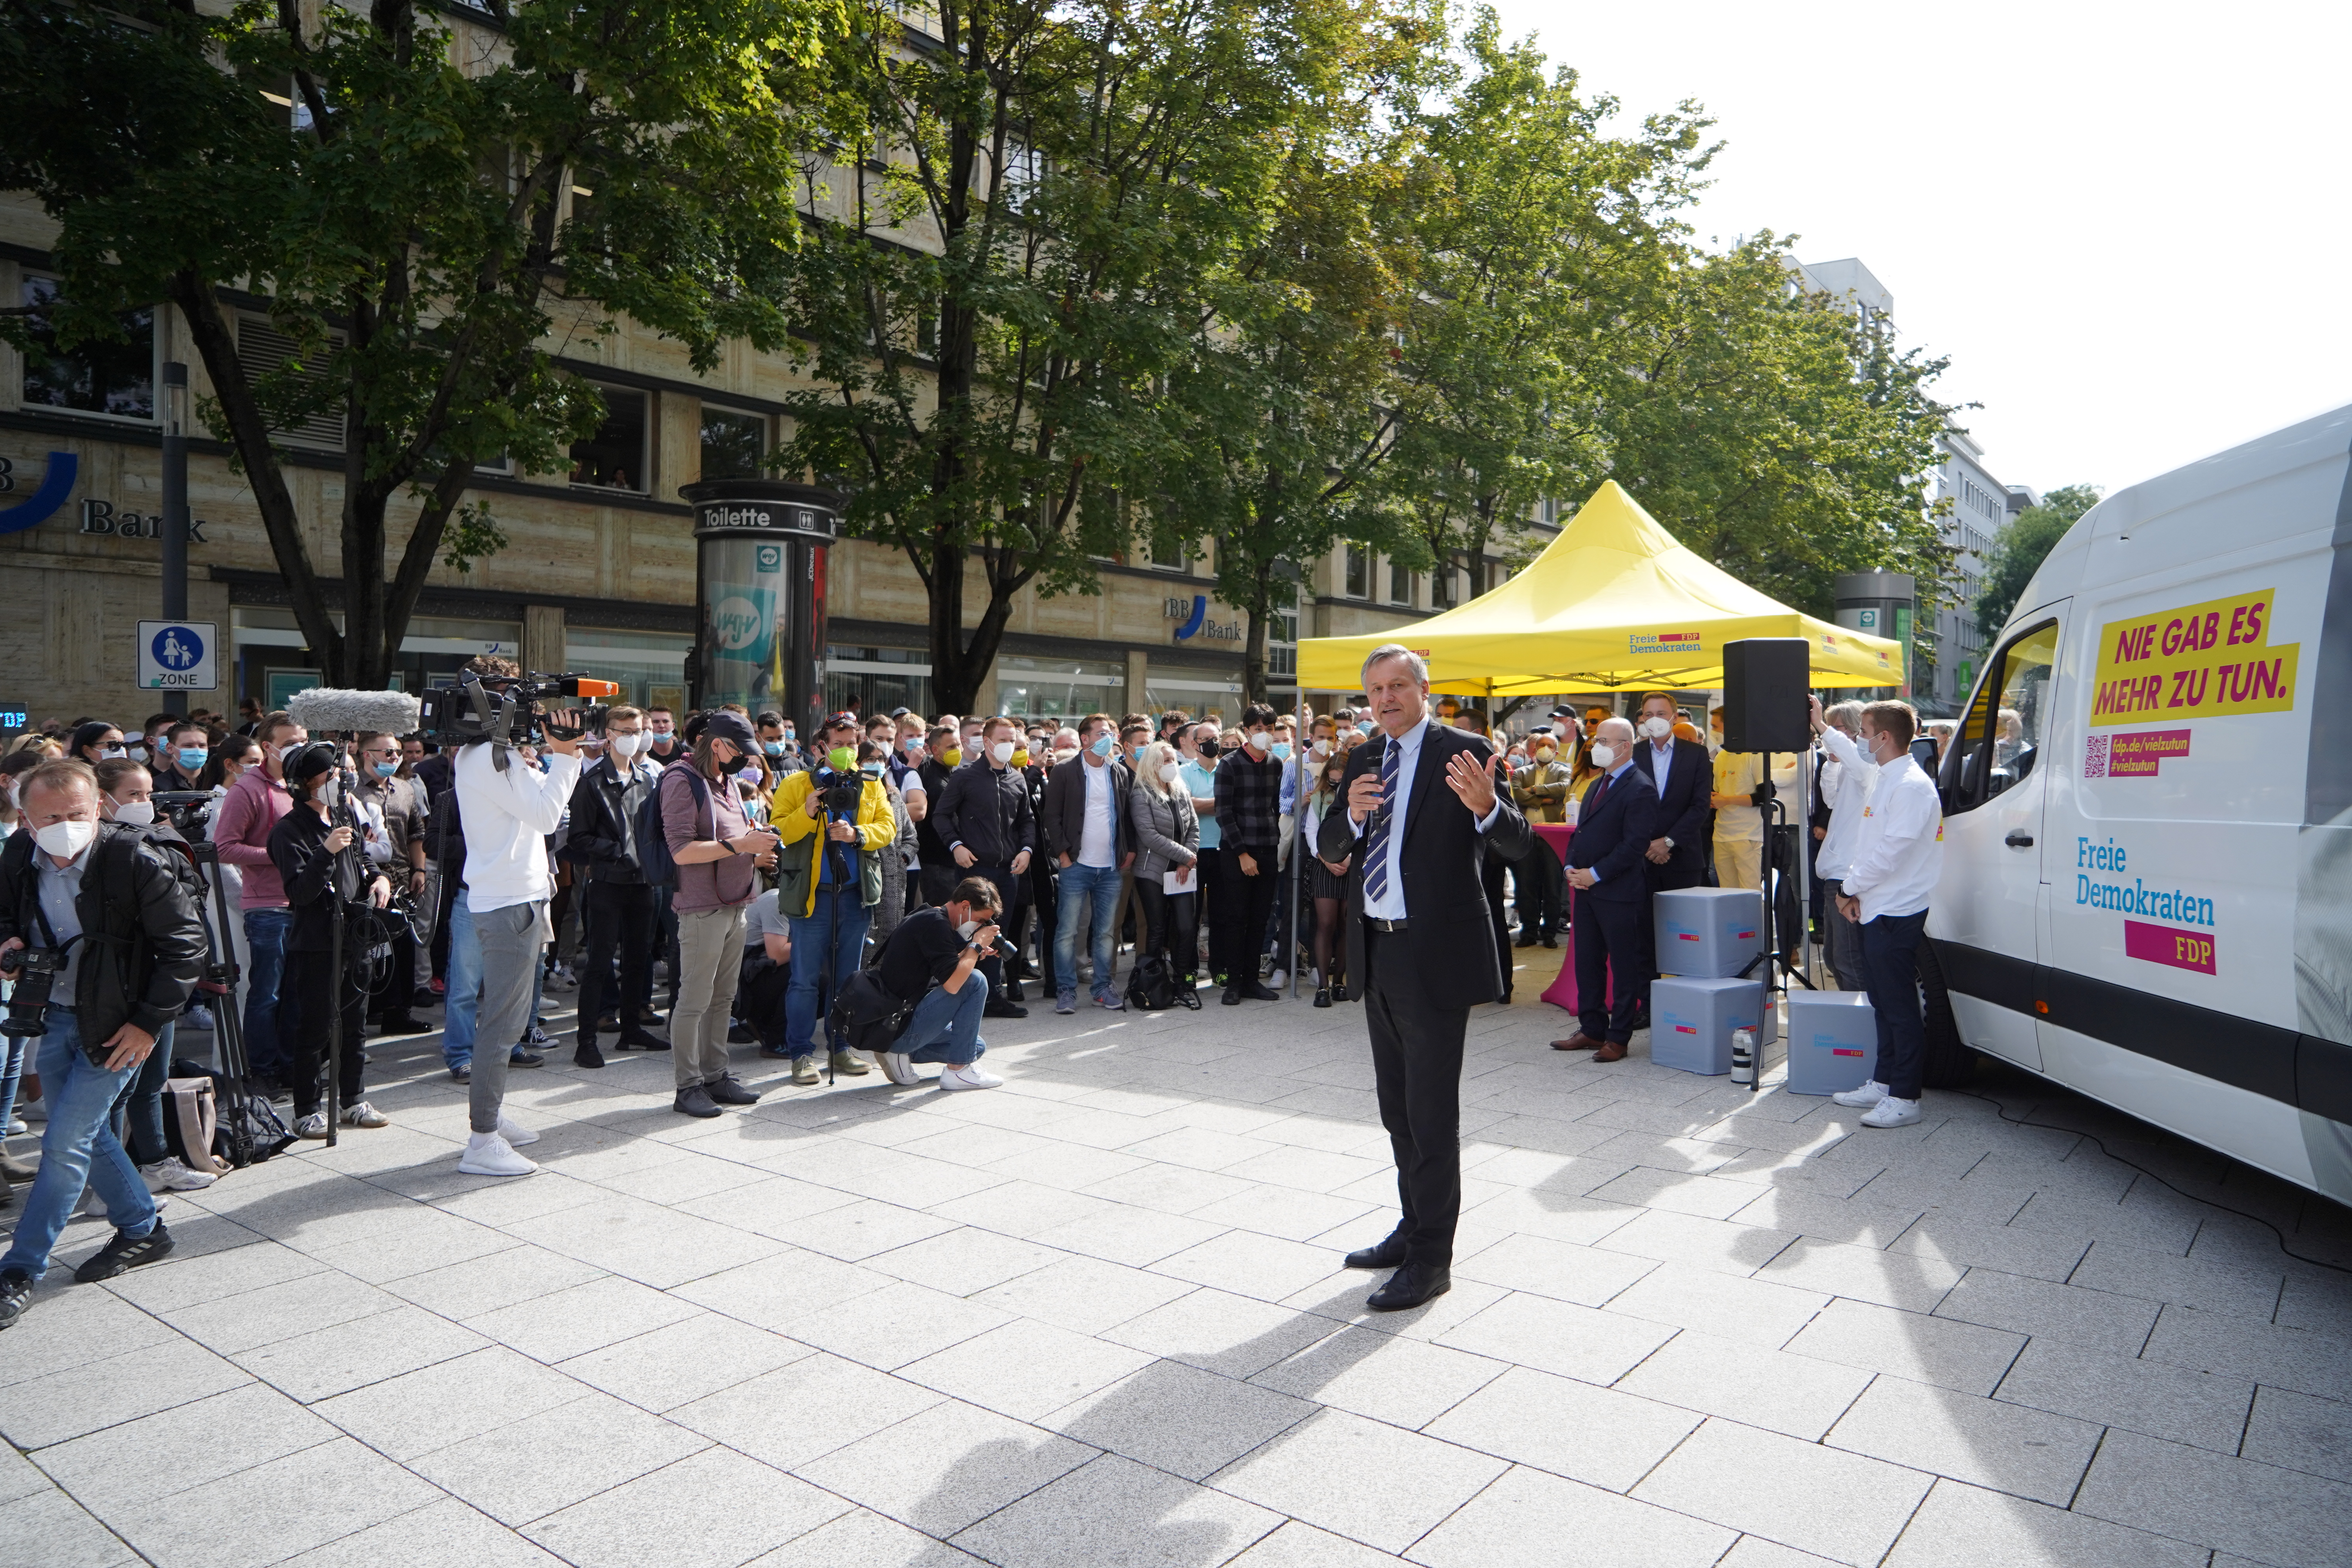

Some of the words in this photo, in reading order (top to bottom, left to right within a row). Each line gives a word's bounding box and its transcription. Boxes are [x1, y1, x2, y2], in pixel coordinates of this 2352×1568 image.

[705, 507, 770, 526] Toilette
[1165, 598, 1189, 619] BB
[1205, 620, 1241, 641] Bank
[1629, 634, 1657, 644] Freie
[2114, 624, 2157, 664] NIE
[2161, 612, 2220, 656] GAB
[2227, 603, 2265, 646] ES
[1629, 643, 1701, 654] Demokraten
[159, 673, 198, 685] ZONE
[2094, 675, 2162, 715] MEHR
[2167, 668, 2209, 708] ZU
[2217, 658, 2287, 703] TUN.
[2112, 736, 2187, 757] fdp.de/vielzutun
[2111, 757, 2156, 772] #vielzutun
[2078, 837, 2126, 872] Freie
[2076, 873, 2214, 926] Demokraten
[2175, 936, 2211, 965] FDP
[1814, 1041, 1864, 1050] Demokraten
